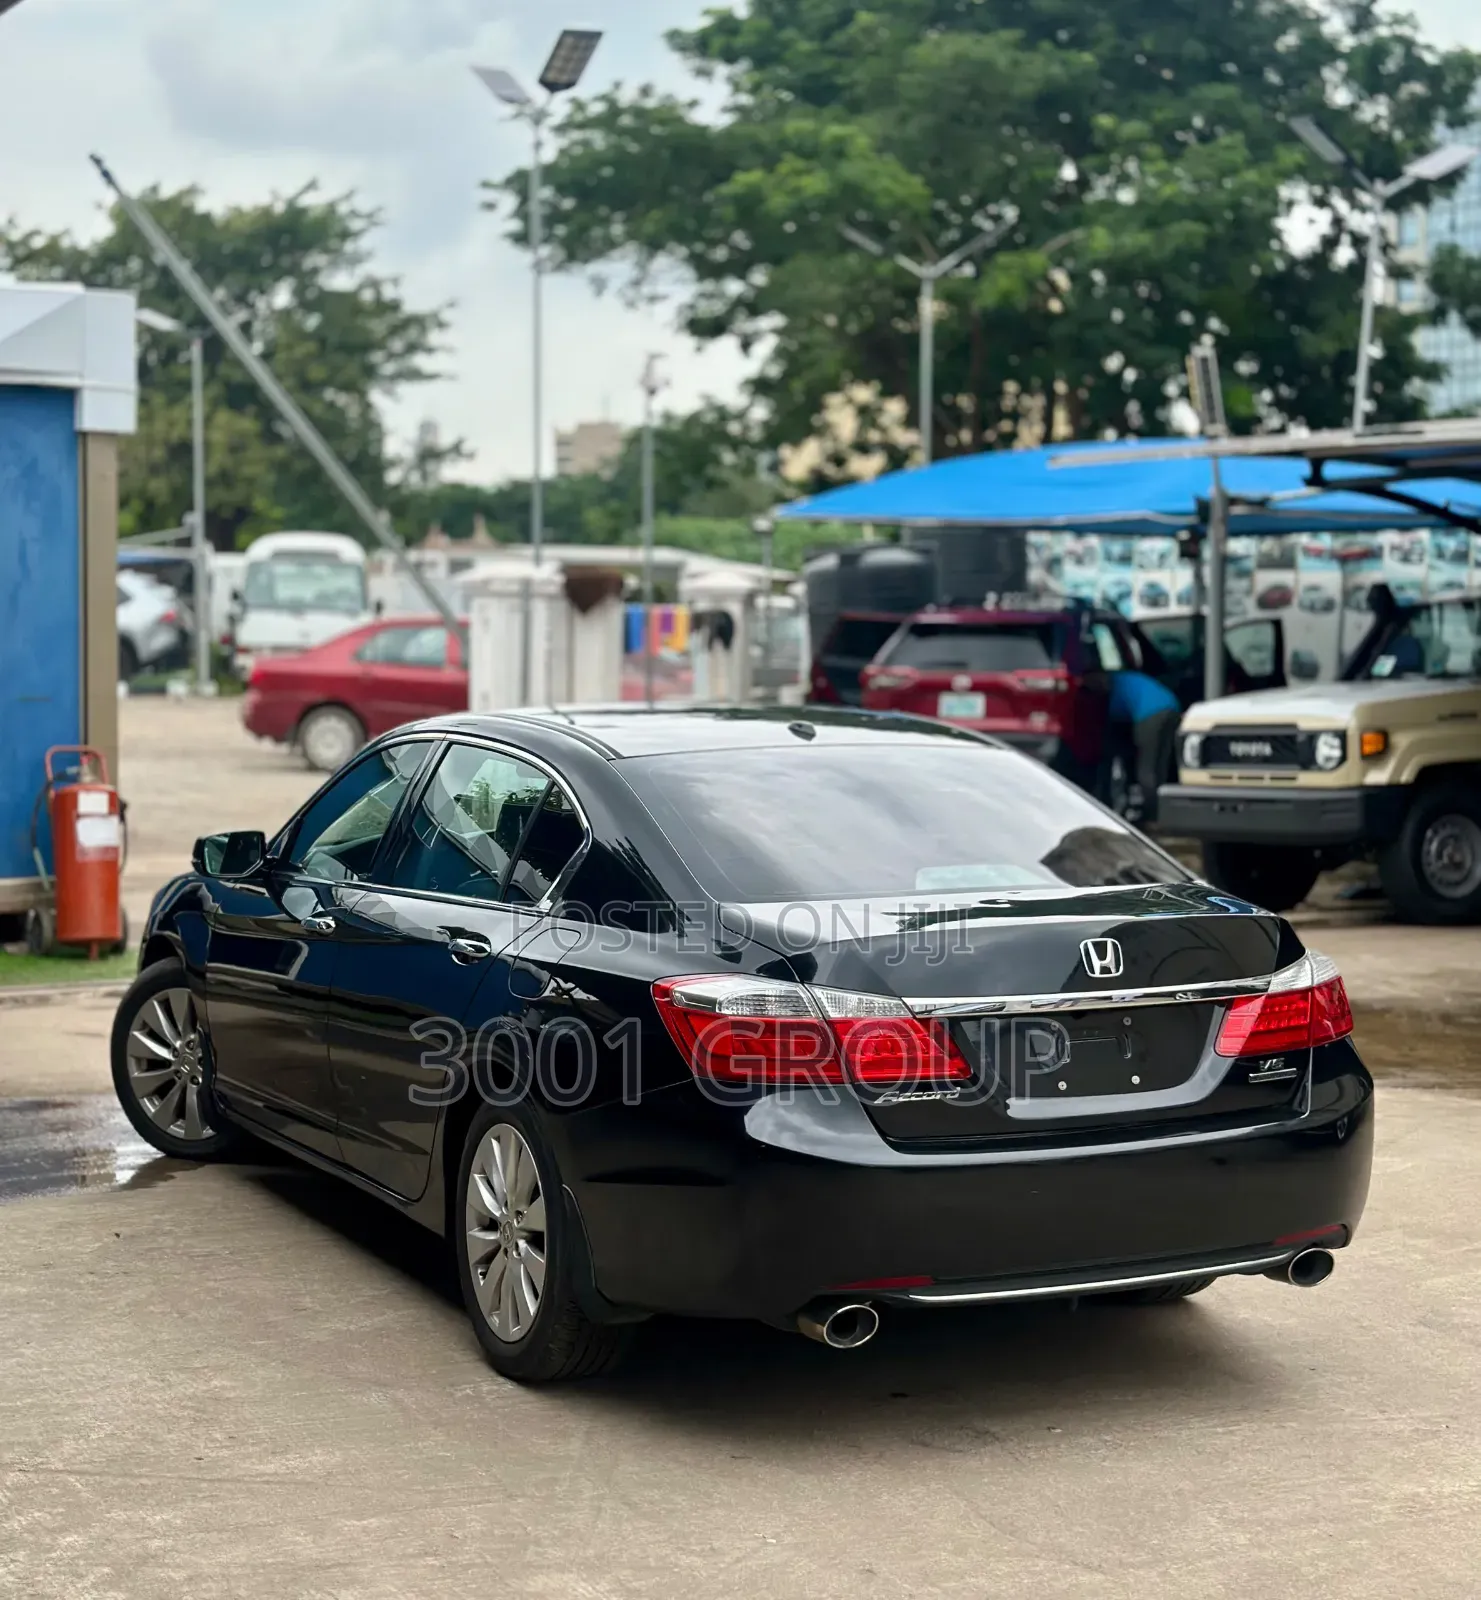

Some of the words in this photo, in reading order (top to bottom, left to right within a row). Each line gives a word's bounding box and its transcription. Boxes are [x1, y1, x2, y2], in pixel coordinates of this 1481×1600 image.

[1229, 741, 1272, 757] TOYOTA
[1259, 1057, 1285, 1071] V6
[873, 1086, 961, 1104] Accord
